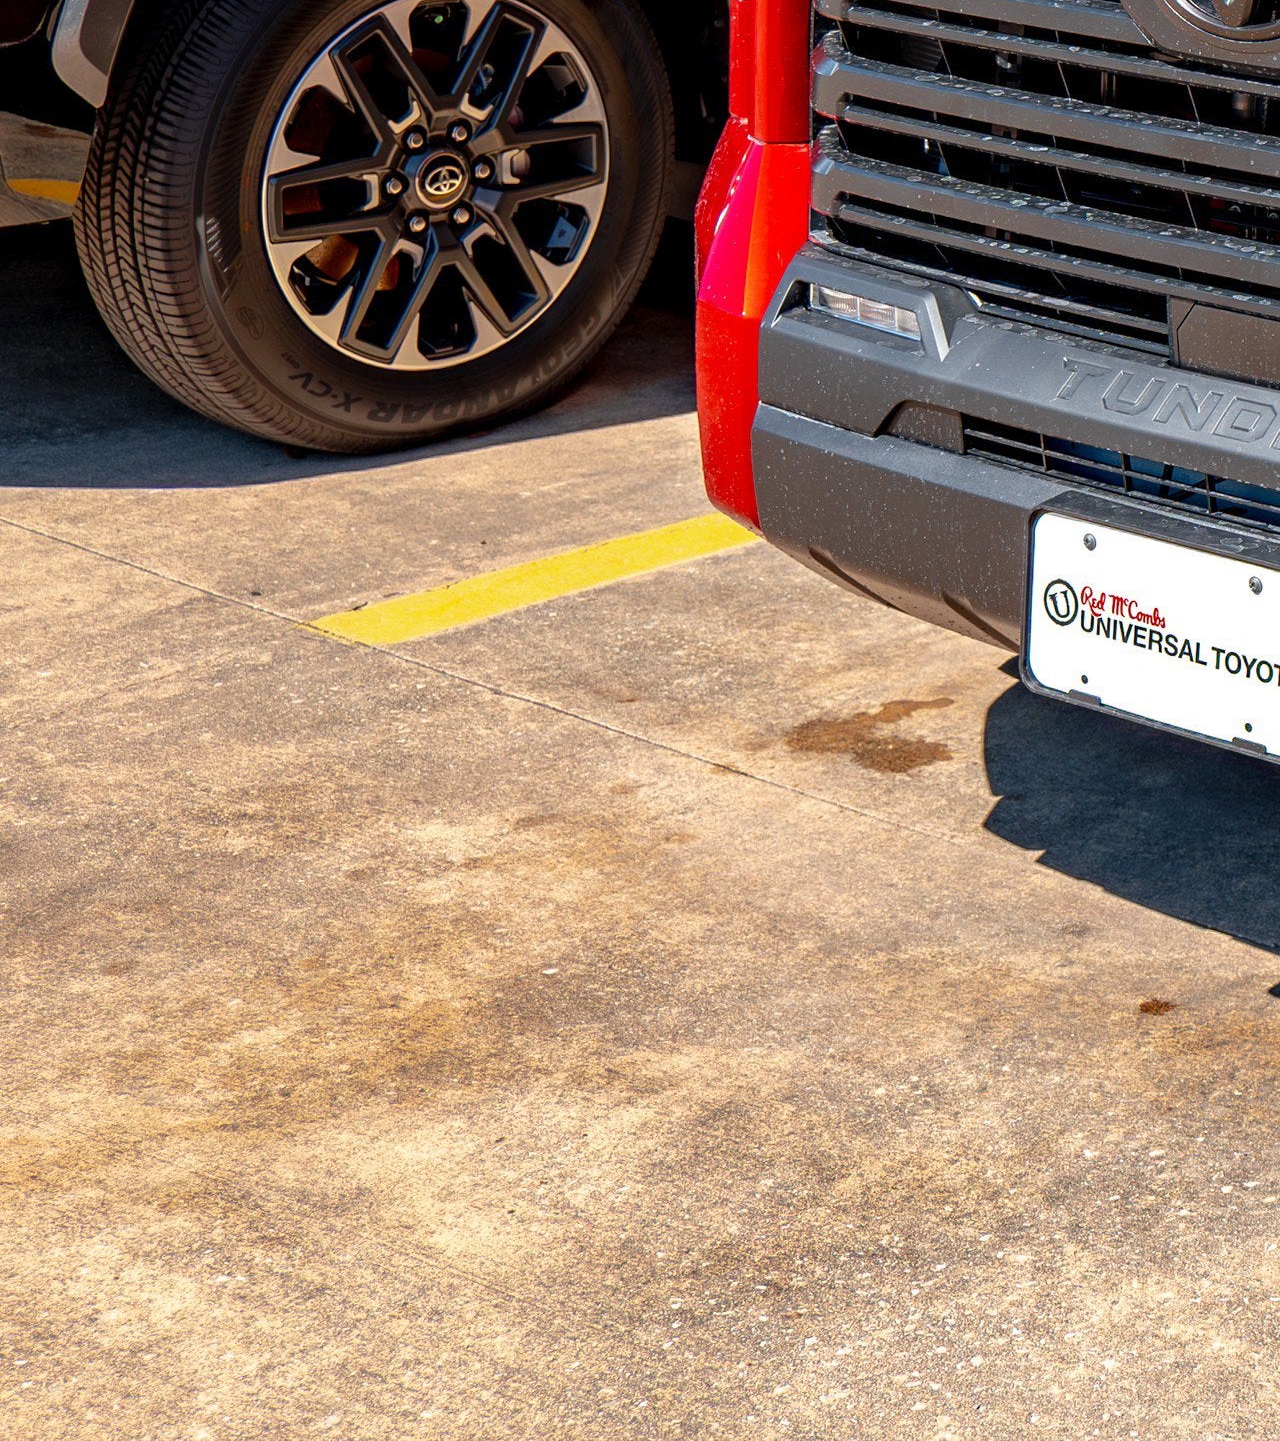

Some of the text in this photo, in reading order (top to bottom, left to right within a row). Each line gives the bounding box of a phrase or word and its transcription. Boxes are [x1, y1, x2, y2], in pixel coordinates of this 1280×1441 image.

[366, 315, 597, 425] GEOLANDAR
[1080, 585, 1166, 629] Red McCombs
[1080, 609, 1208, 666] UNIVERSAL
